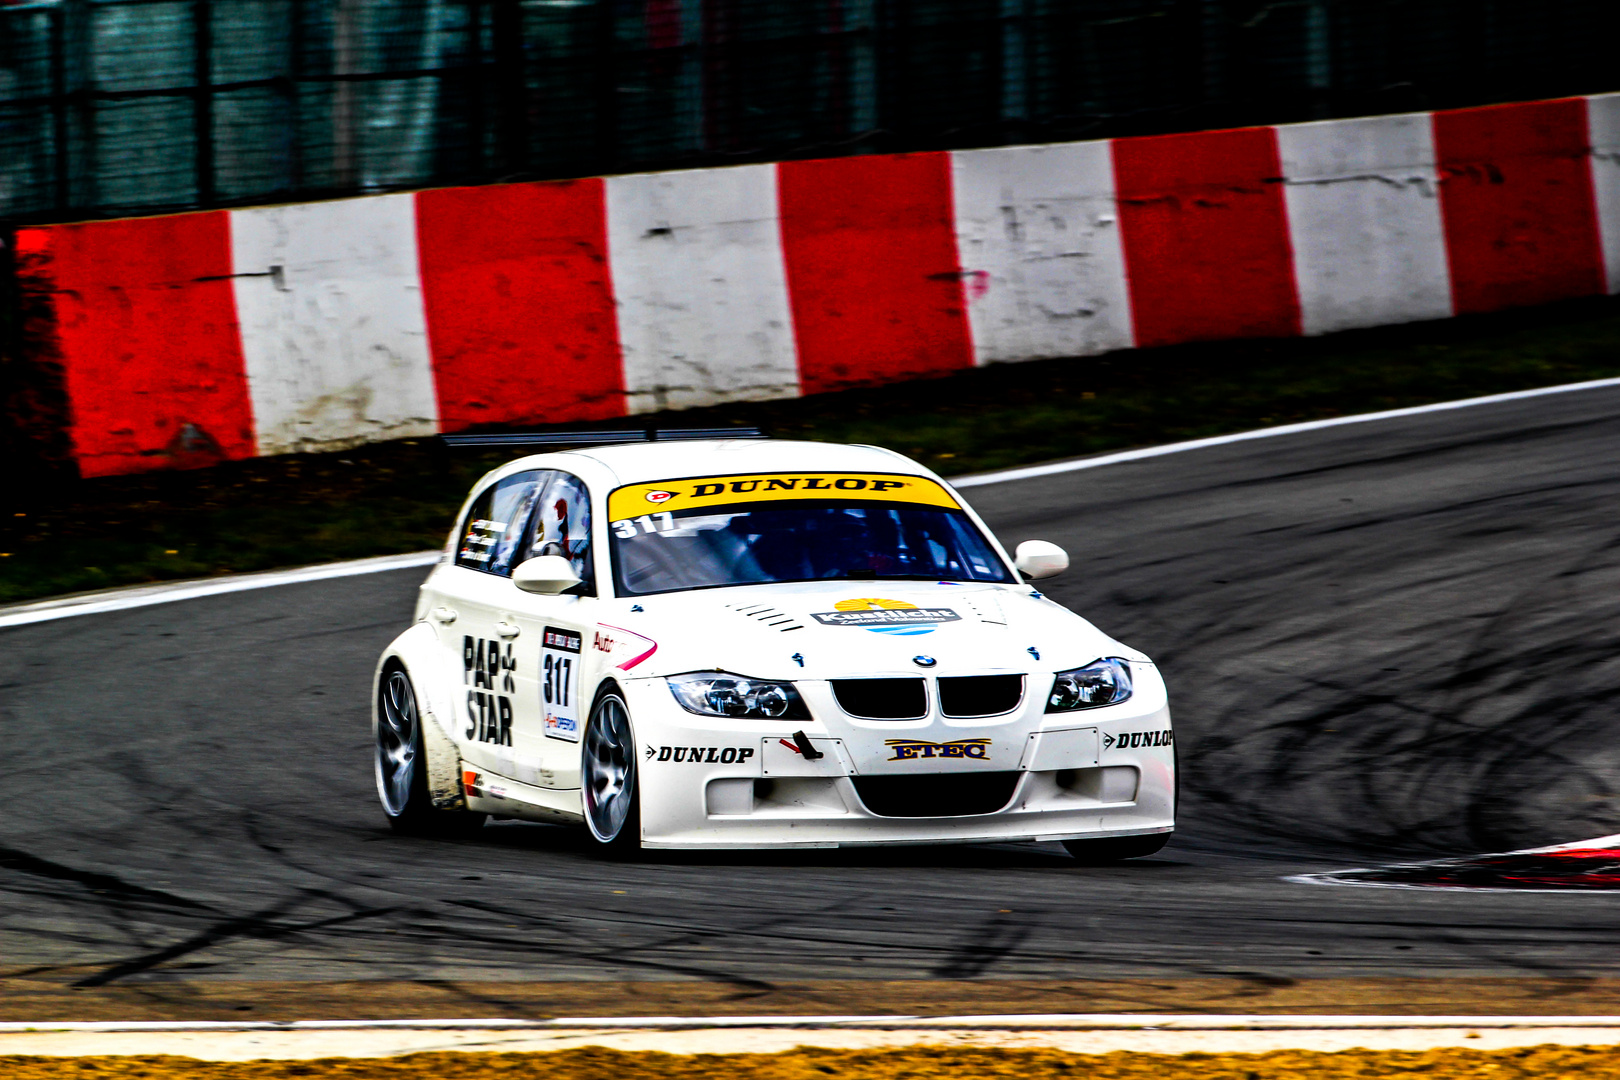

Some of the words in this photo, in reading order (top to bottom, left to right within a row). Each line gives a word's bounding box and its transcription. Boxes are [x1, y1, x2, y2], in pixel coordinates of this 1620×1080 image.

[690, 478, 906, 498] DUNLOP
[612, 511, 675, 540] 317
[817, 609, 956, 622] Kustlicht
[463, 635, 500, 691] PAP
[543, 653, 572, 707] 317
[465, 689, 513, 747] STAR
[657, 746, 754, 764] DUNLOP
[886, 743, 991, 761] ETEC
